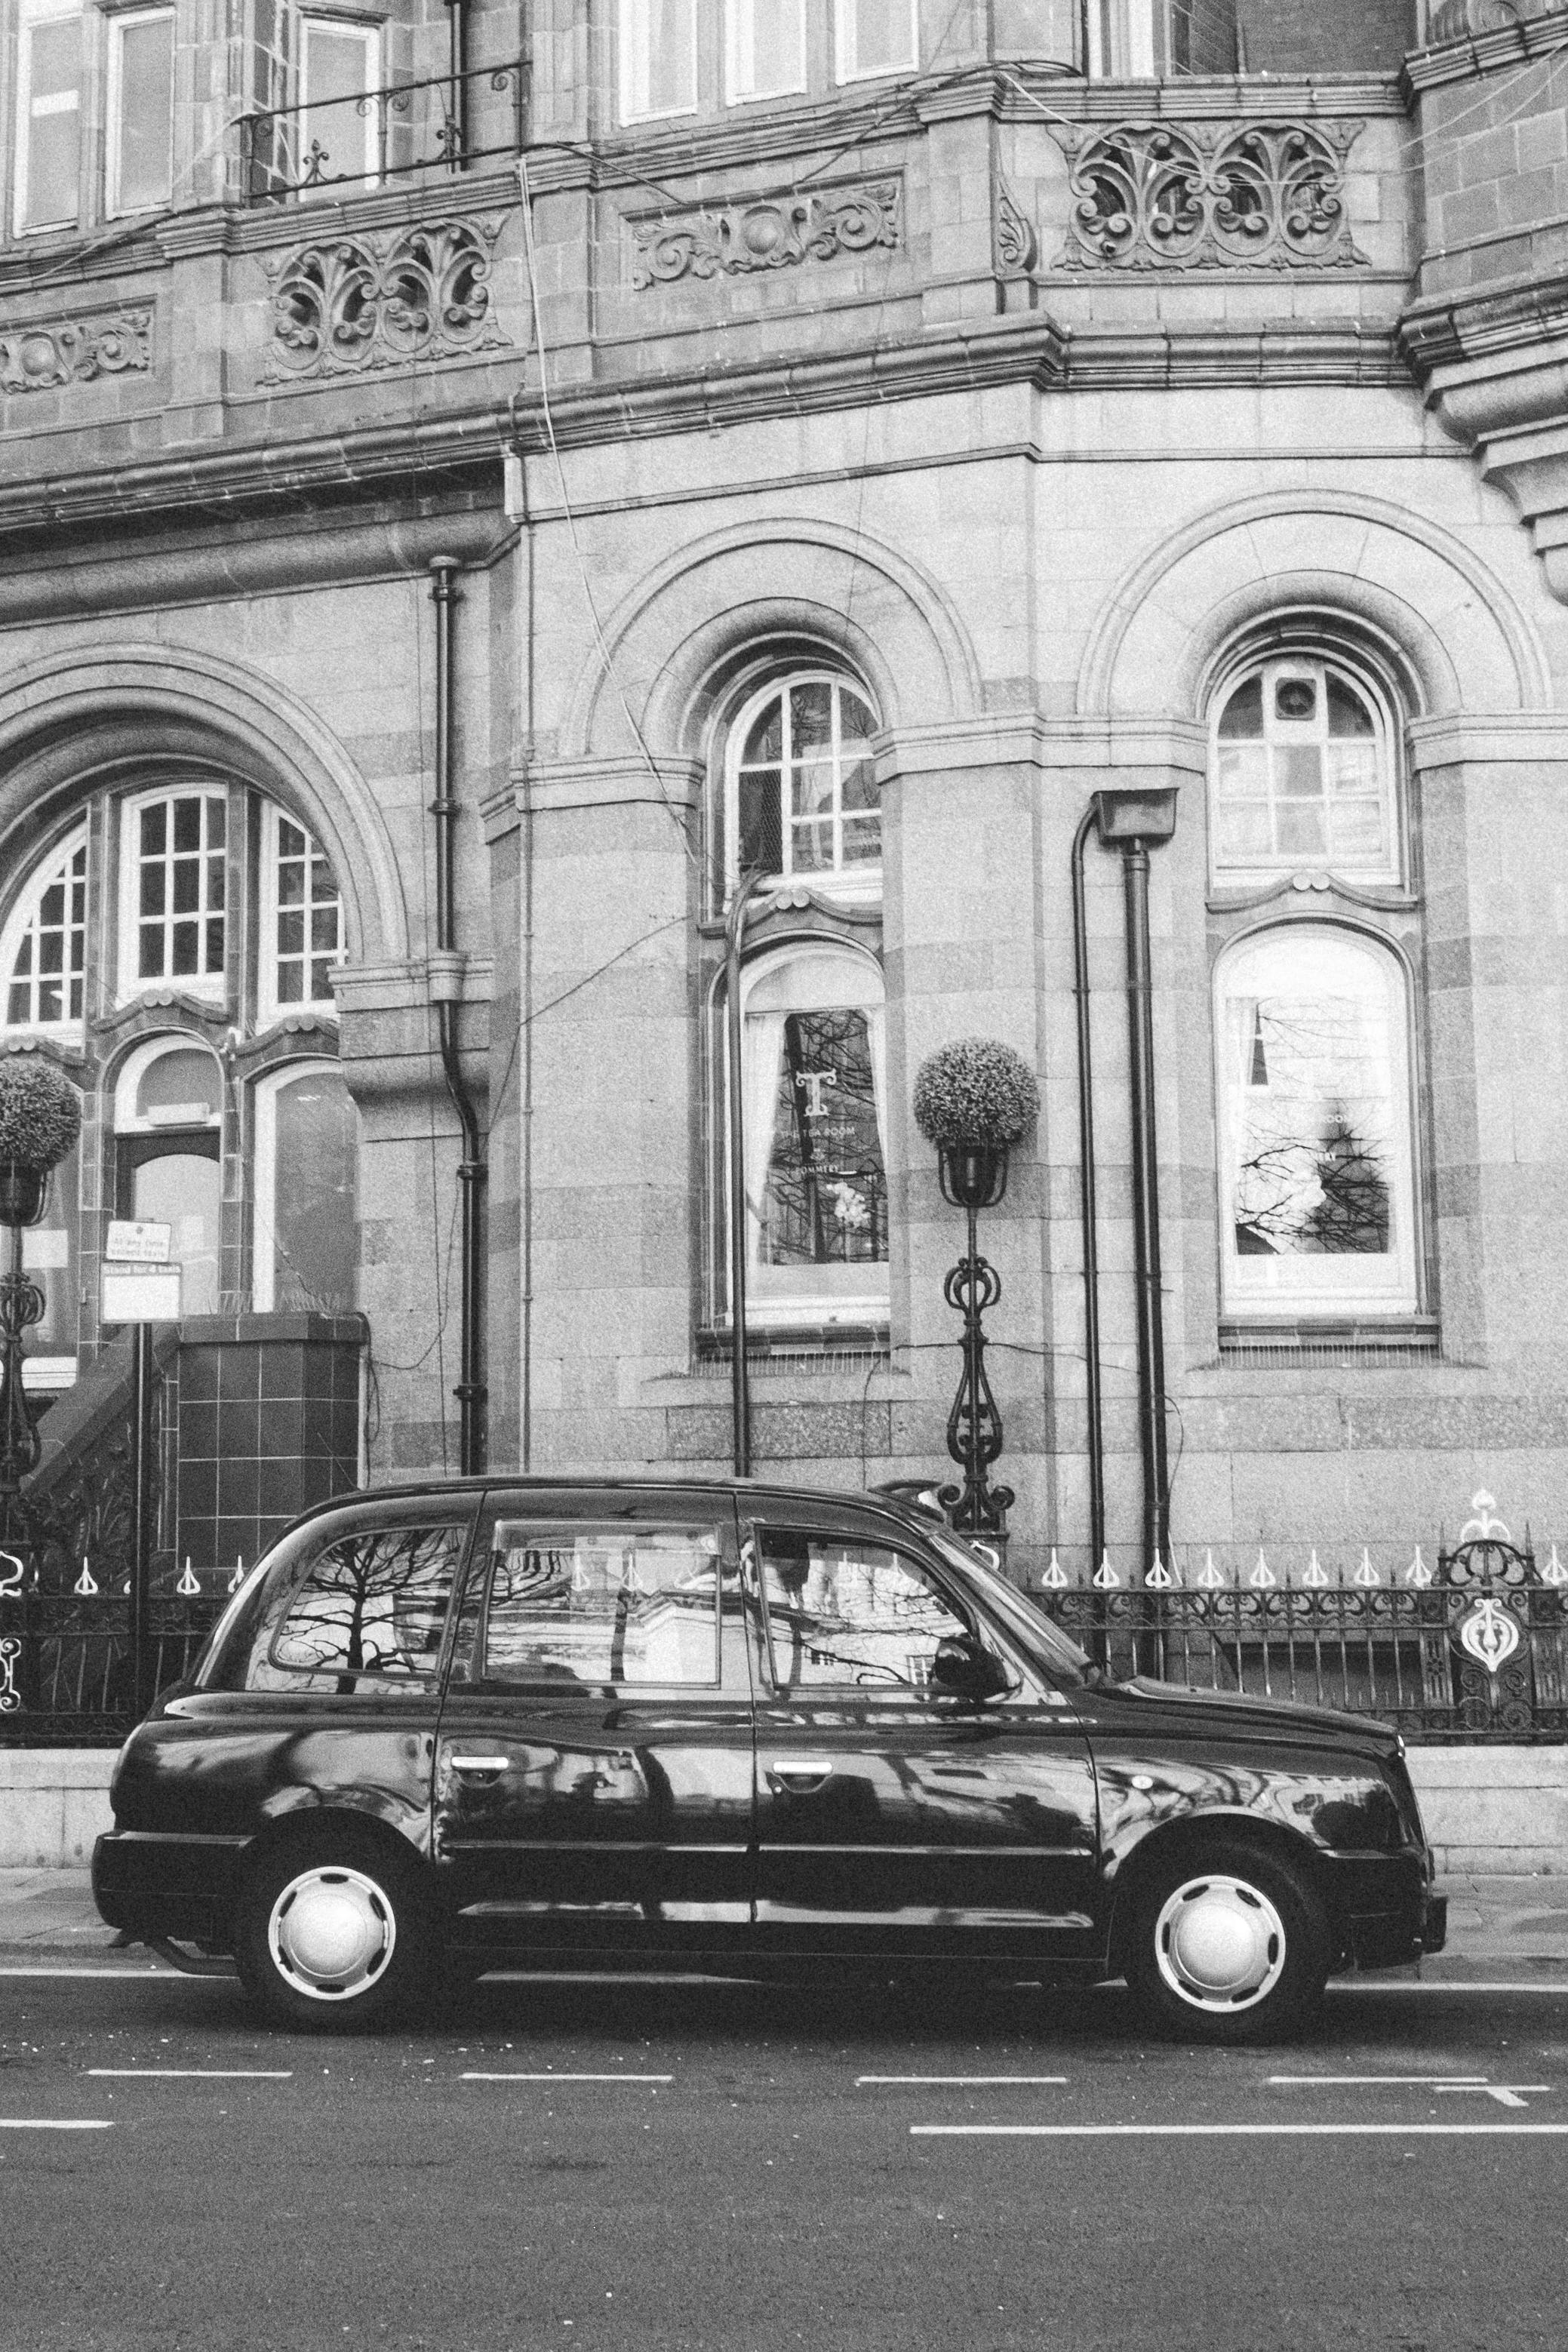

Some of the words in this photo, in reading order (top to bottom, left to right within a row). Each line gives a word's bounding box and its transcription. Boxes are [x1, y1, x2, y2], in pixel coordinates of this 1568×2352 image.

[795, 1068, 837, 1117] T
[802, 1129, 821, 1137] TEA
[823, 1126, 856, 1136] ROOM
[103, 1265, 131, 1274] Stand
[133, 1265, 147, 1274] for
[158, 1265, 181, 1274] taxis
